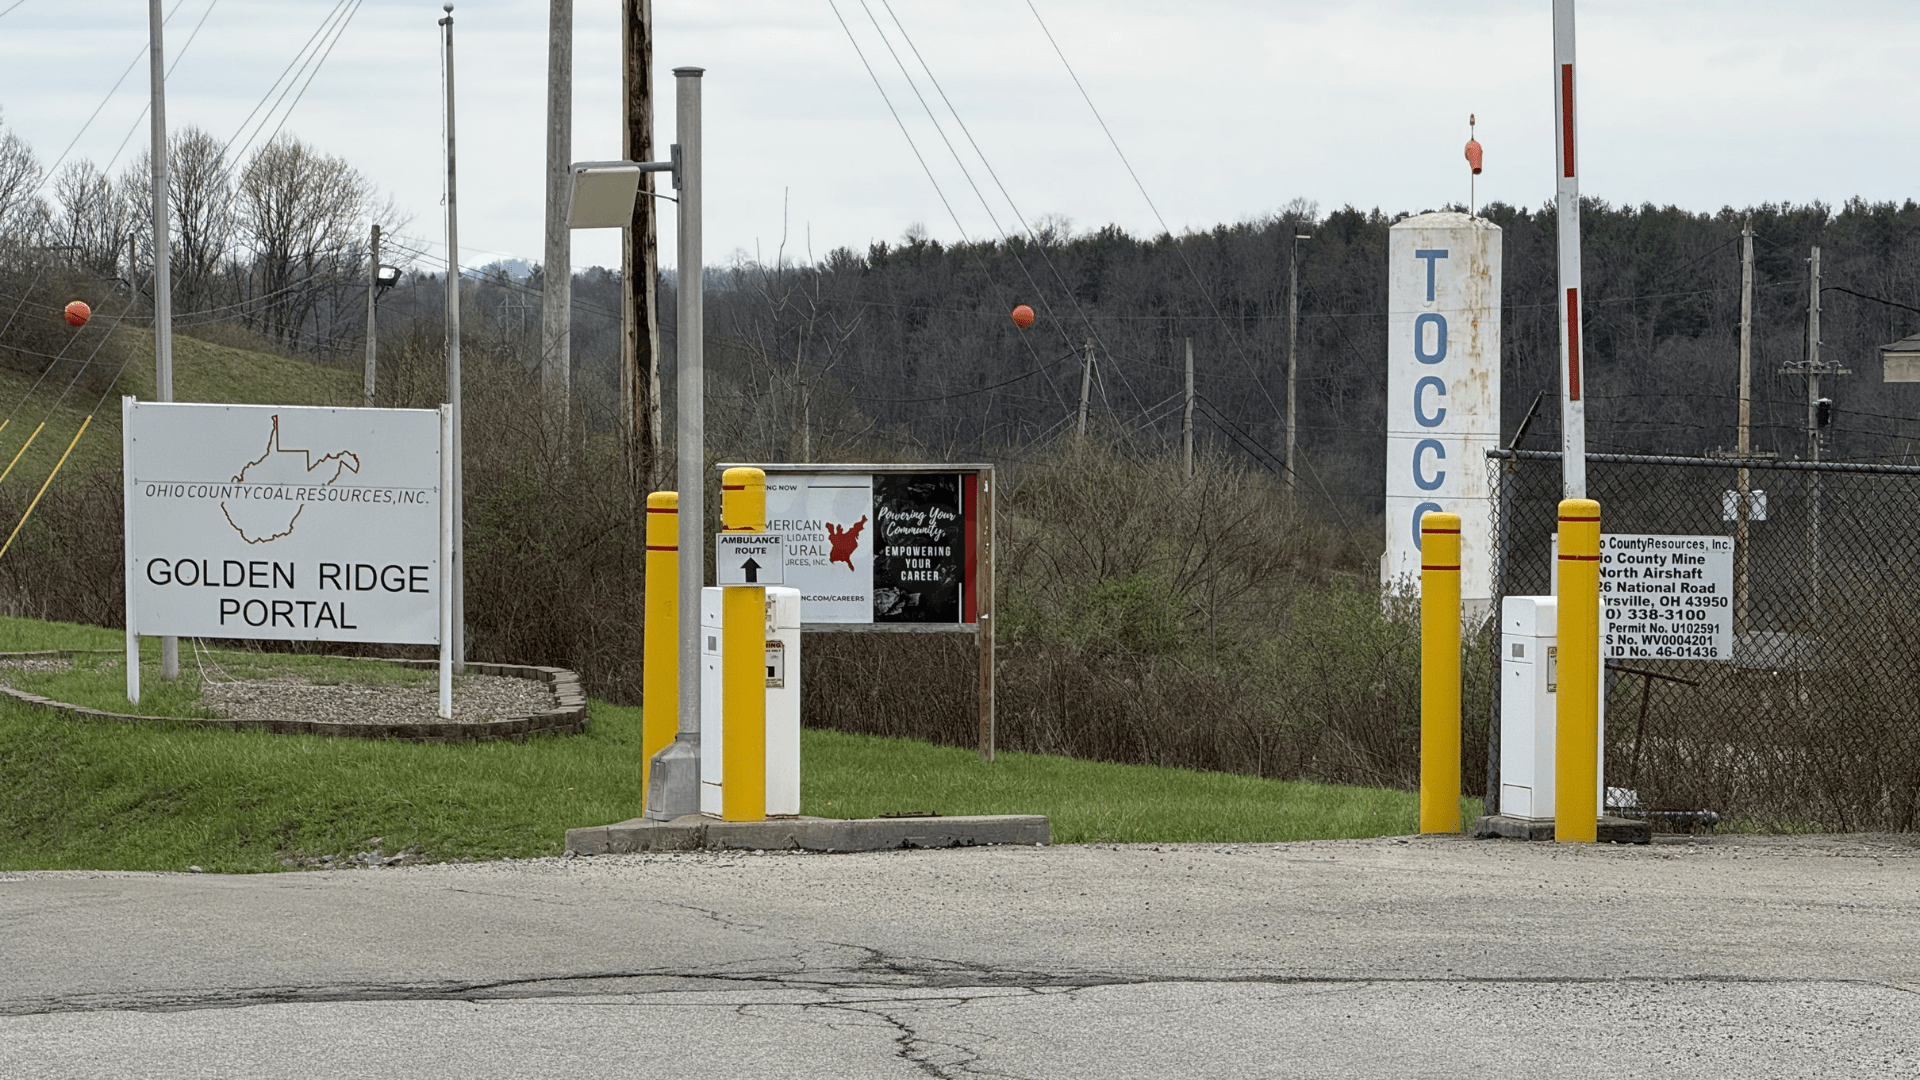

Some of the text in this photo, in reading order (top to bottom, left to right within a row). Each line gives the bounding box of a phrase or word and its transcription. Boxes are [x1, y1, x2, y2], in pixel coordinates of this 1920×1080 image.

[877, 506, 956, 525] Powering Your
[886, 520, 946, 542] Community,
[720, 535, 780, 544] AMBULANCE
[785, 533, 825, 542] LIDATED
[785, 544, 827, 556] URAL
[1711, 539, 1732, 550] Inc.
[735, 547, 767, 555] ROUTE
[885, 545, 951, 557] EMPOWERING
[812, 558, 828, 566] INC.
[905, 558, 931, 569] YOUR
[1617, 552, 1668, 567] County
[1672, 553, 1706, 565] Mine
[146, 558, 430, 594] GOLDEN RIDGE
[901, 570, 939, 581] CAREER
[1643, 567, 1703, 580] Airshaft
[1617, 581, 1676, 593] National
[1680, 582, 1716, 594] Road
[1659, 595, 1681, 607] OH
[1685, 596, 1728, 608] 43950
[220, 598, 358, 630] PORTAL
[1627, 608, 1706, 621] 338-3100
[1609, 622, 1720, 635] Permit No. U102591
[1617, 634, 1638, 645] No.
[1641, 635, 1713, 646] WV0004201
[1610, 646, 1625, 657] ID
[1629, 646, 1652, 657] No.
[1655, 646, 1718, 658] 46-01436
